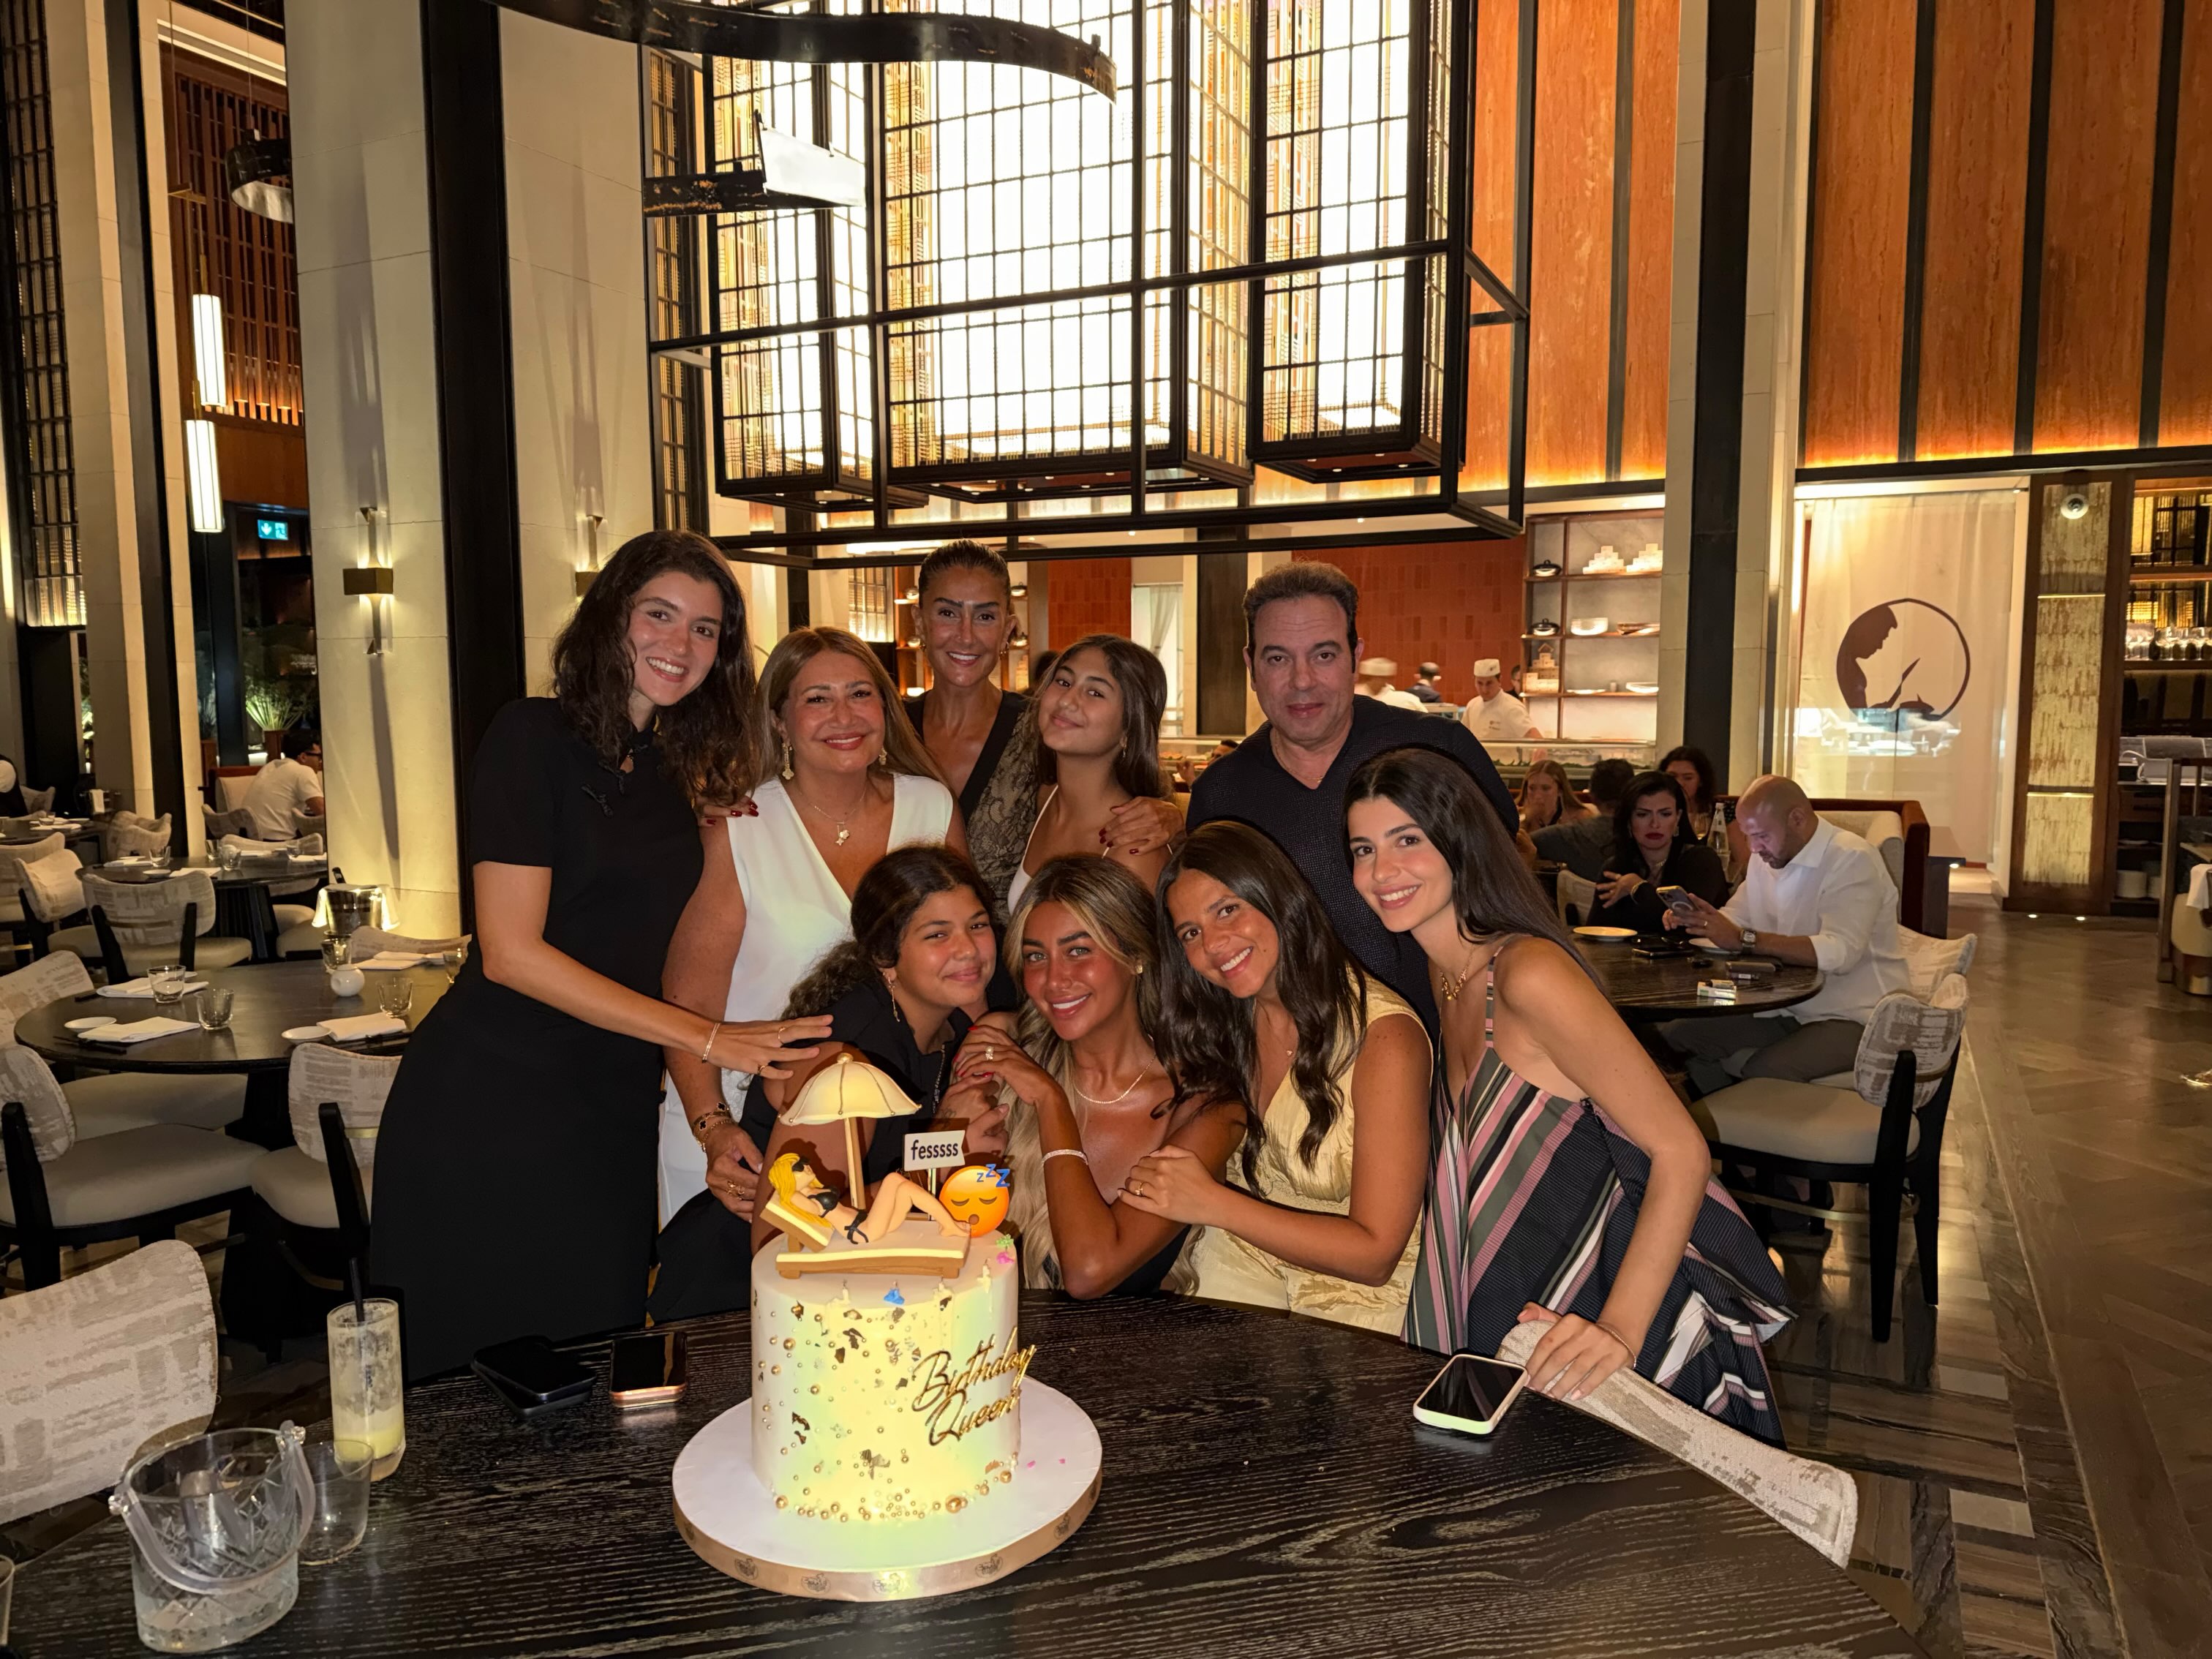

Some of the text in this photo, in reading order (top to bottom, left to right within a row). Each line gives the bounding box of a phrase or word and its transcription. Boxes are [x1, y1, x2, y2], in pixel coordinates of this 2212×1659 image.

[911, 1139, 958, 1160] fesssss
[912, 1326, 1037, 1411] Birthday
[925, 1388, 1020, 1446] Queen
